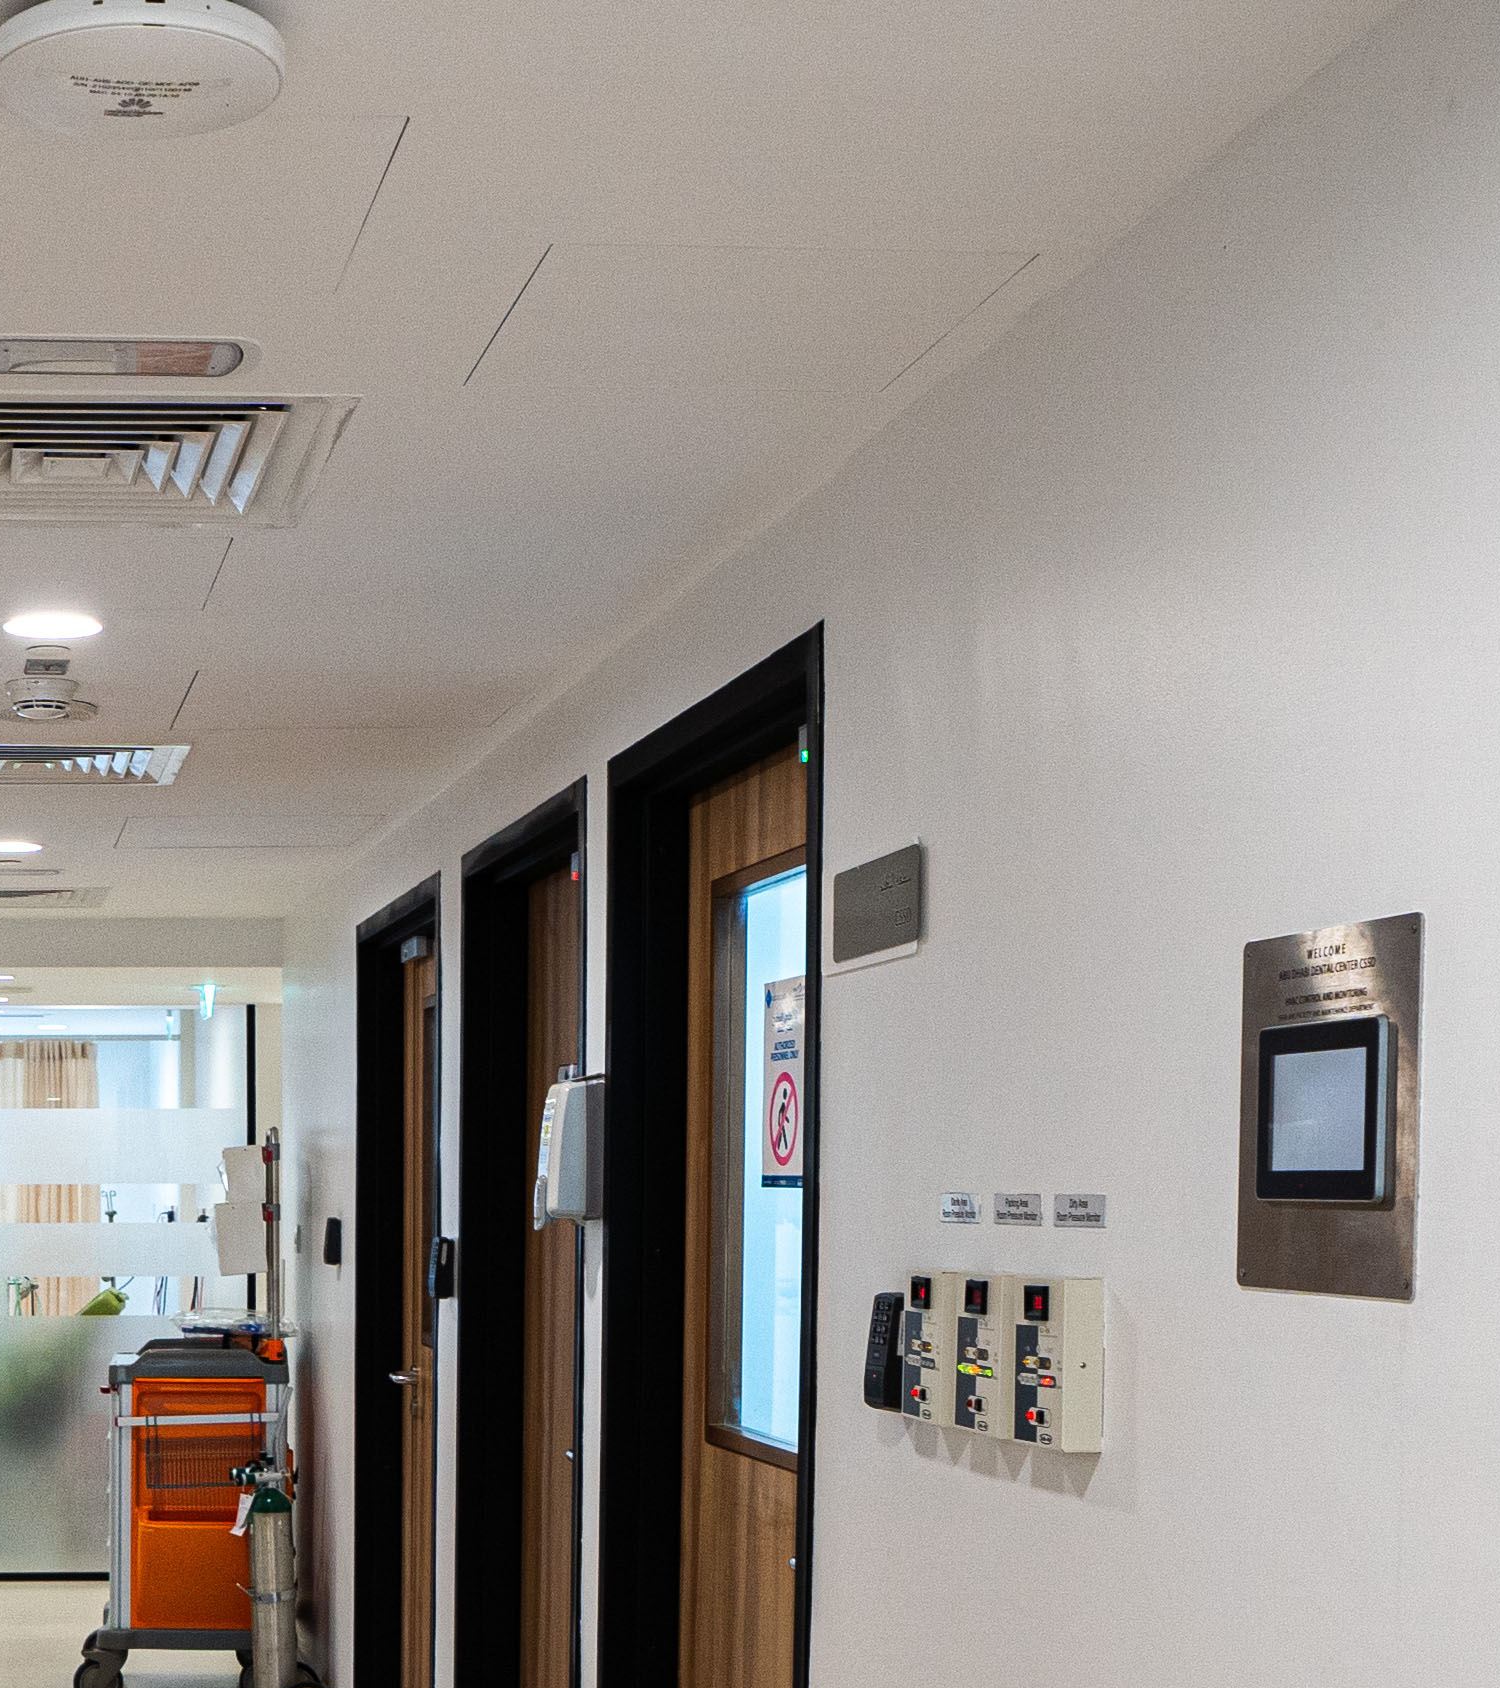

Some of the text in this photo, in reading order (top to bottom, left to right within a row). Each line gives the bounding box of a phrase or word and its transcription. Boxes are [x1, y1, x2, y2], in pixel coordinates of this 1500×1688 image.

[1307, 943, 1346, 959] WELCOME
[1311, 963, 1334, 976] DENTAL
[1335, 959, 1358, 973] CENTER
[1360, 957, 1376, 969] CSSD
